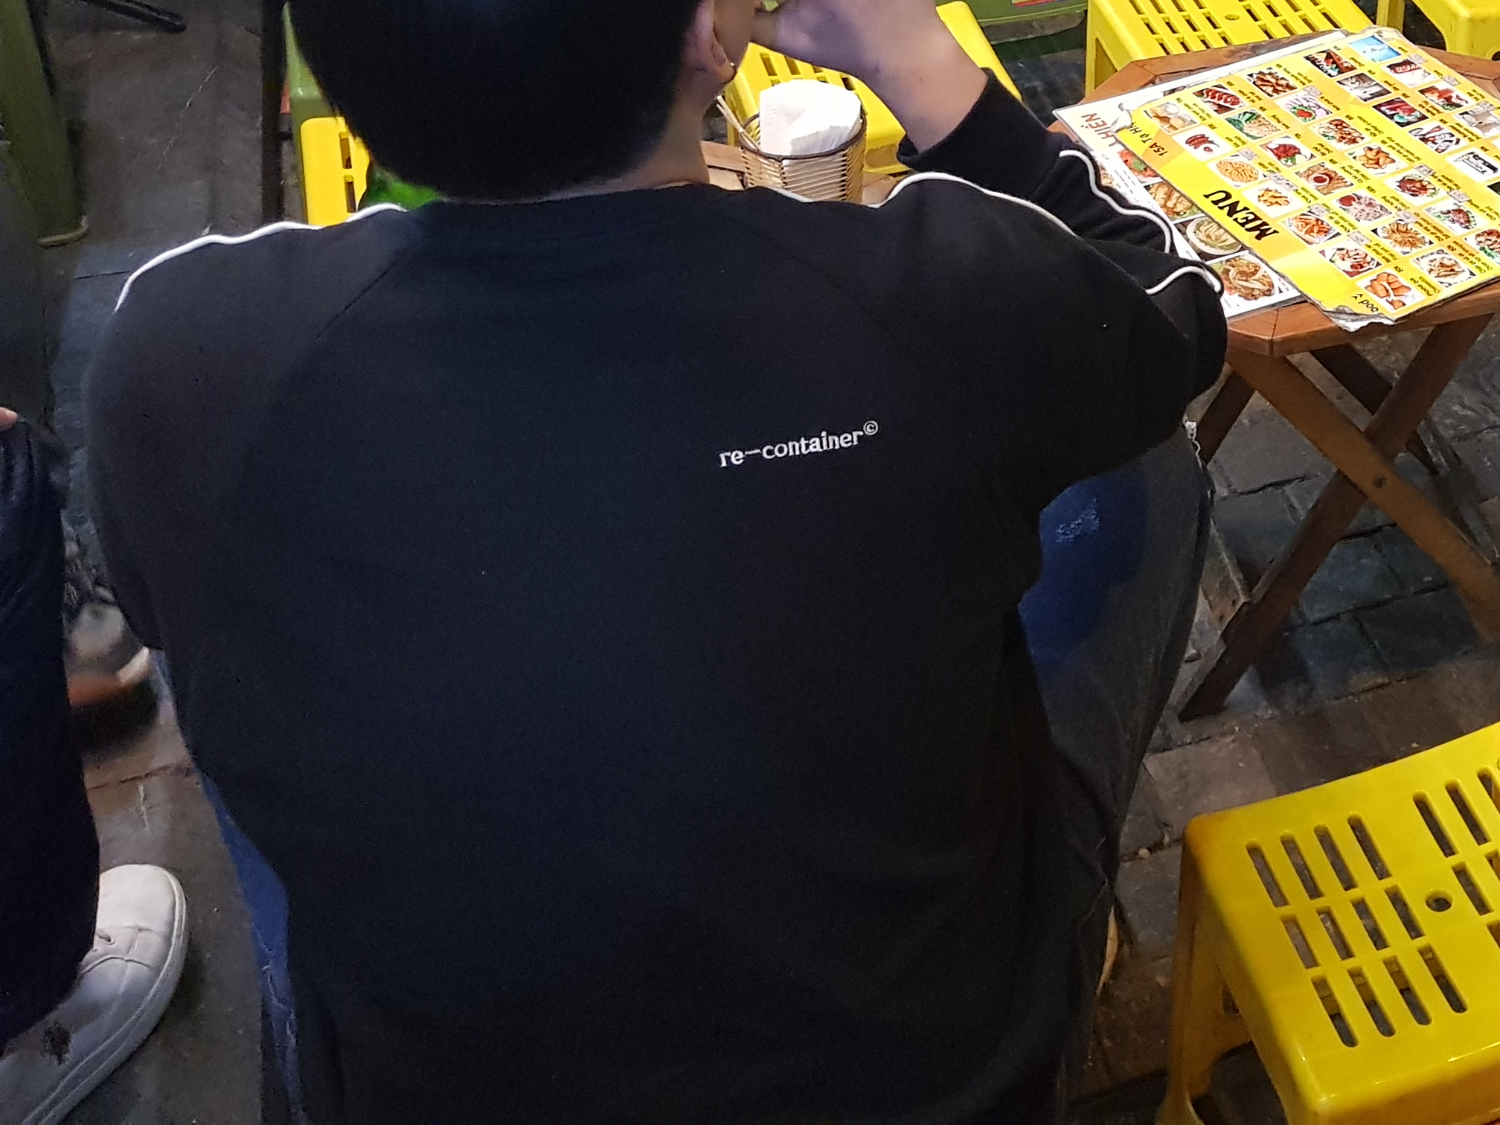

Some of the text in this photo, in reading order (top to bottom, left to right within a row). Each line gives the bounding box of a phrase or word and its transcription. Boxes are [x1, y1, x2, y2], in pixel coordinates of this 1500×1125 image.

[1150, 142, 1169, 157] 15A
[1204, 190, 1280, 242] MENU
[1361, 298, 1379, 313] ood
